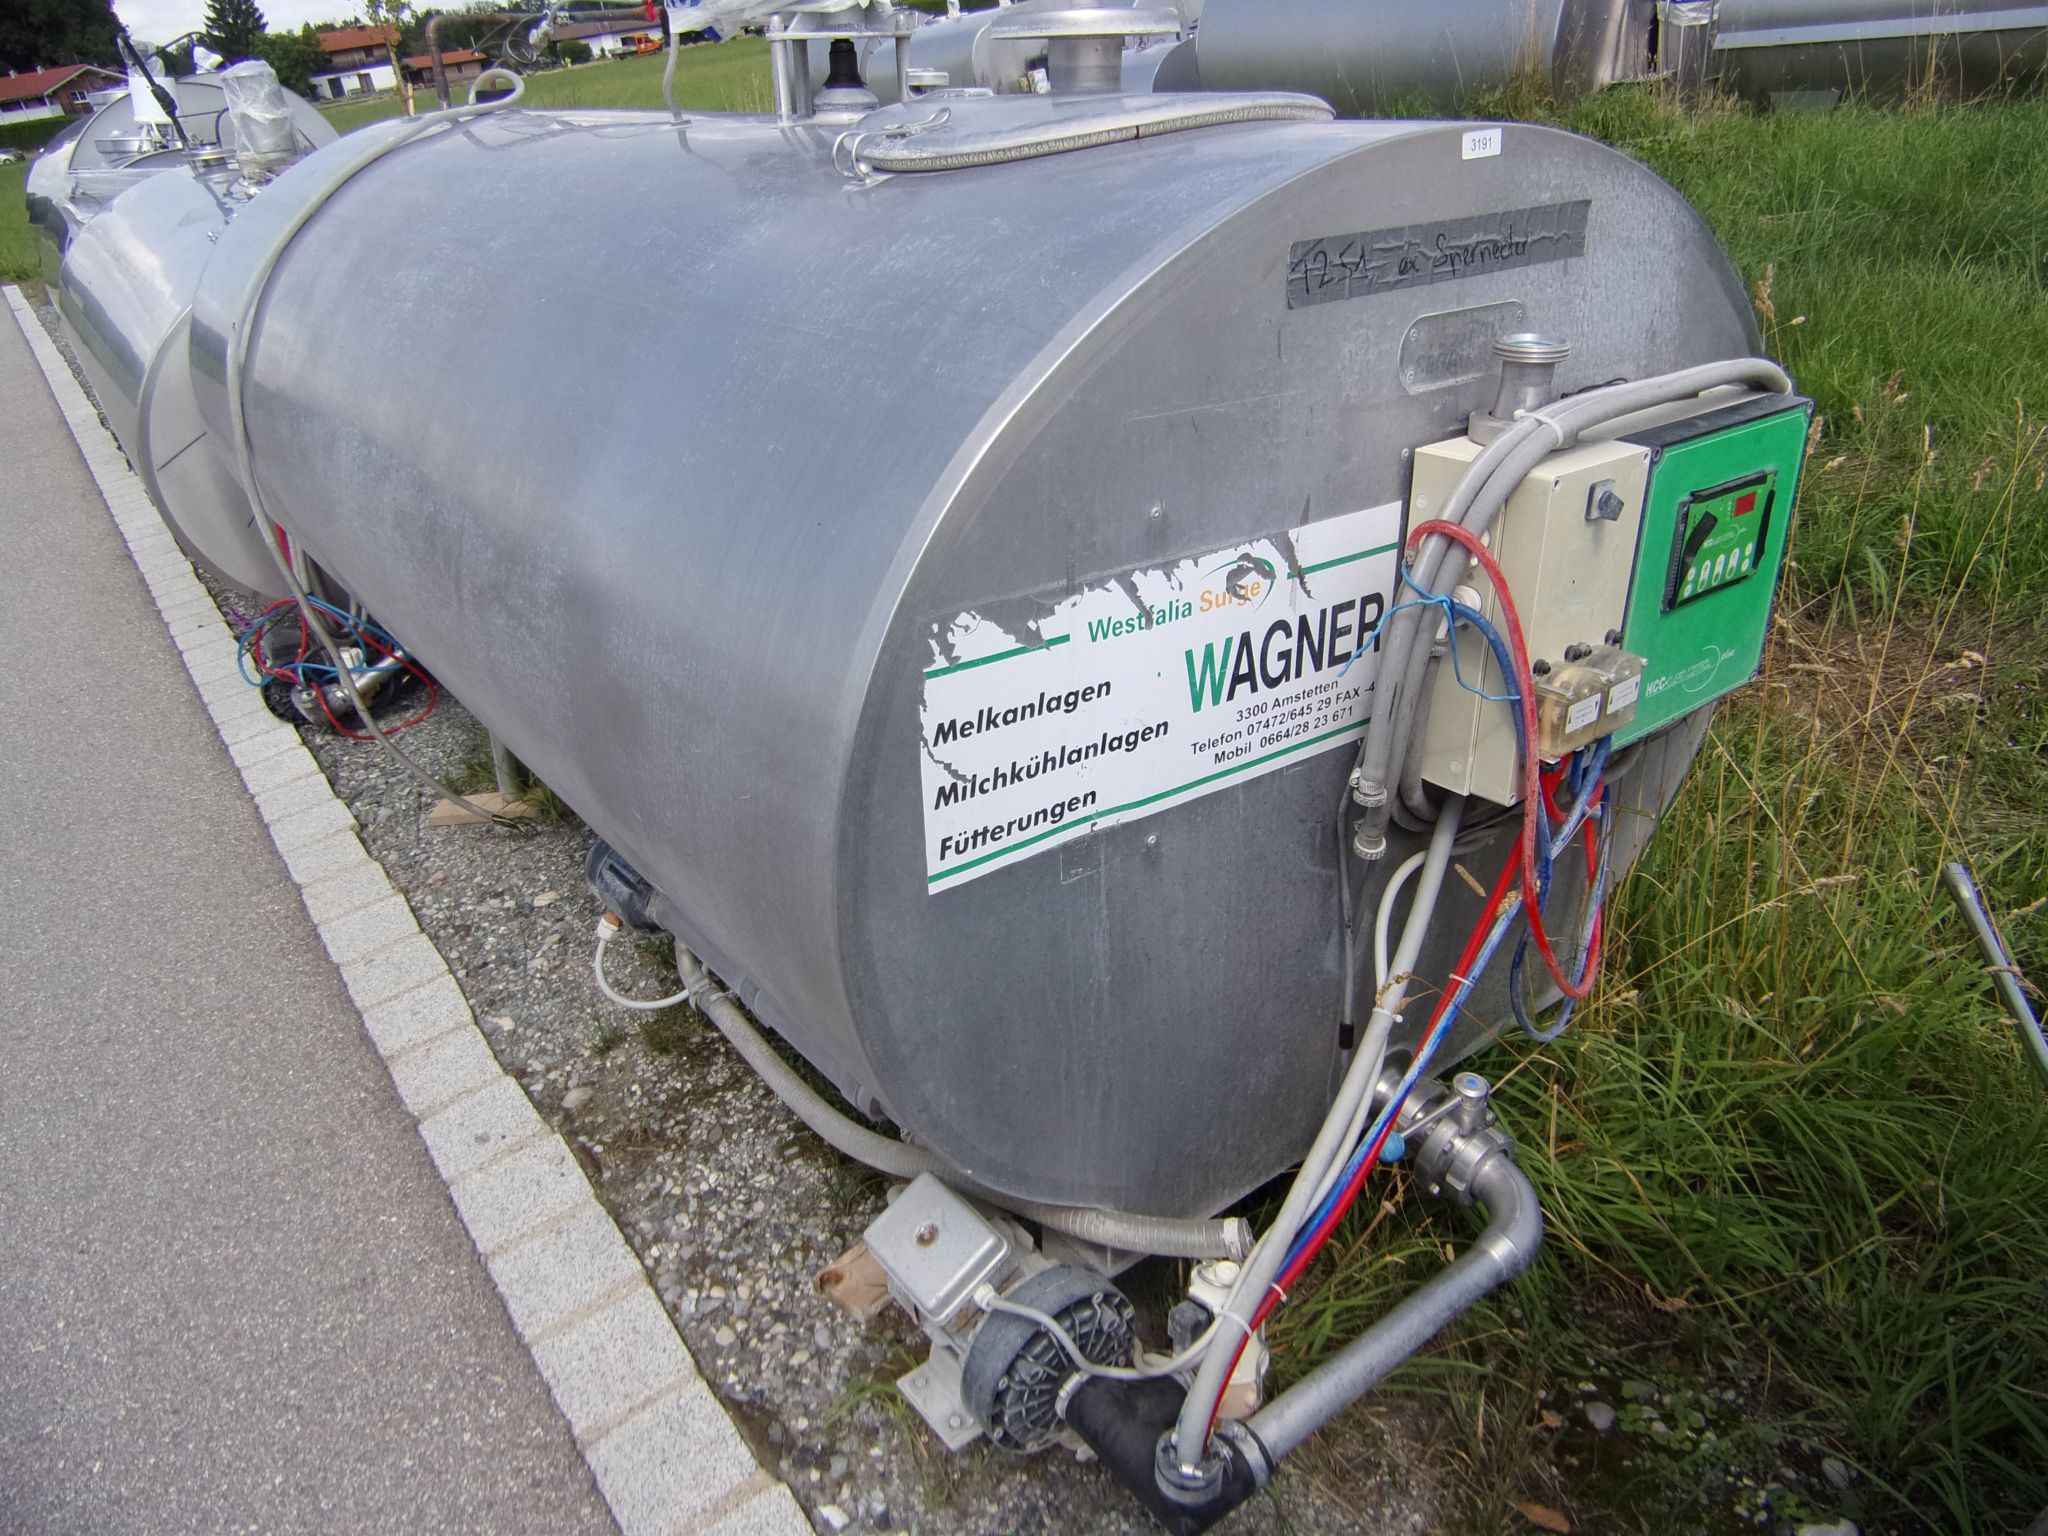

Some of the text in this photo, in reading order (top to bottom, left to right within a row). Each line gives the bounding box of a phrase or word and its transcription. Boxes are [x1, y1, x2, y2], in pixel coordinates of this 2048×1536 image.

[1471, 136, 1492, 152] 3191
[1185, 592, 1385, 713] WAGNER
[933, 680, 1112, 747] Melkanlagen
[1191, 730, 1242, 755] Telefon
[1247, 705, 1313, 736] 07472/645
[1317, 698, 1332, 715] 29
[1336, 686, 1360, 706] FAX
[1214, 705, 1353, 764] Mobil 0664/28 23 671
[1236, 680, 1339, 722] 3300 Amstetten
[934, 720, 1169, 810] Milchkühlanlagen
[939, 790, 1097, 861] Fütterungen
